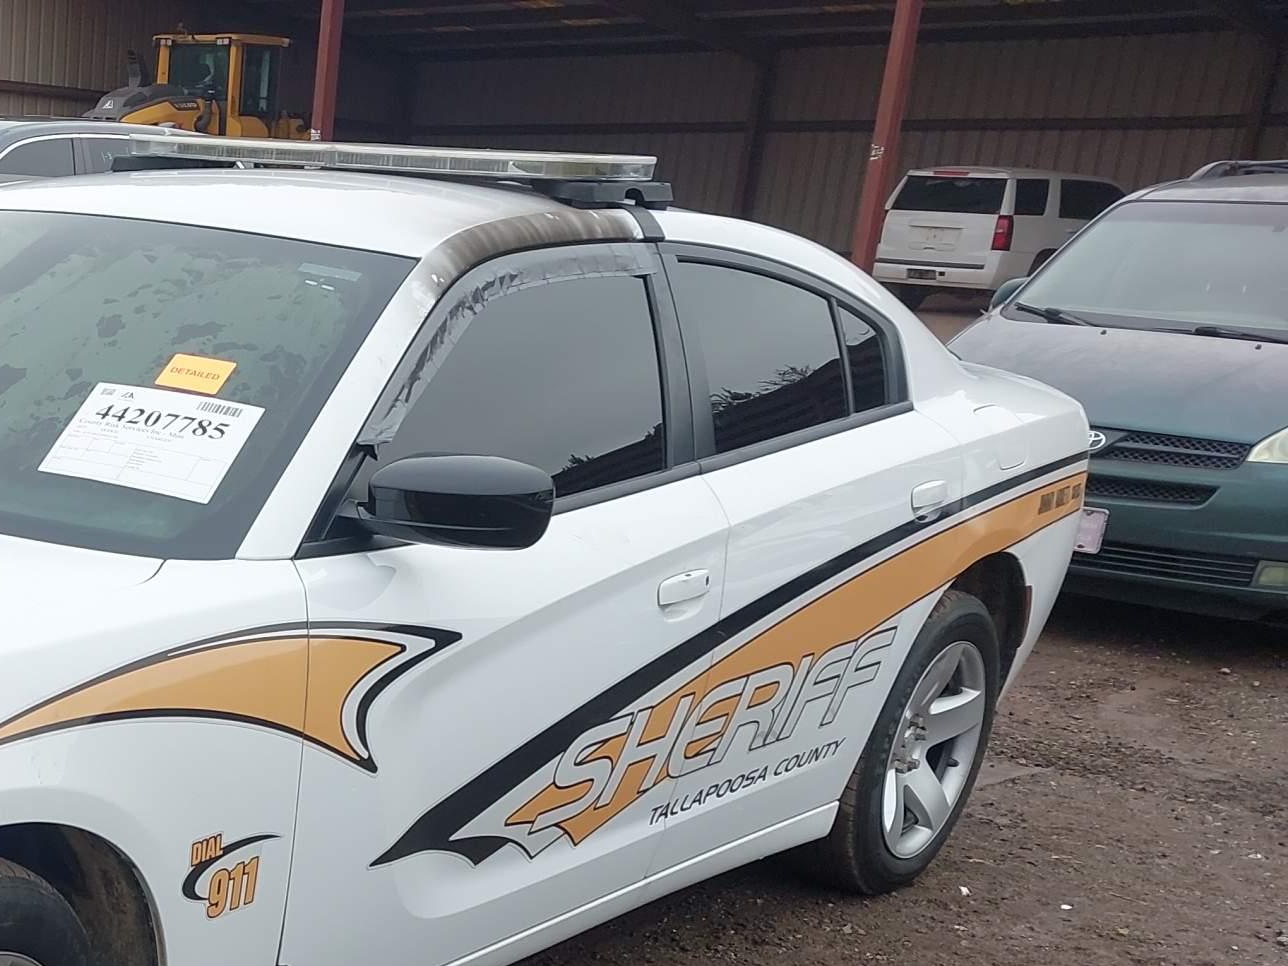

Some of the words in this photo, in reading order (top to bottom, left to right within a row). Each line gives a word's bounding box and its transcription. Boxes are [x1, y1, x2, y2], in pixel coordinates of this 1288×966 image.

[170, 367, 220, 381] DETAILED
[95, 404, 231, 440] 44207785
[529, 626, 897, 835] SHERIFF
[648, 764, 769, 827] TALLAPOOSA
[772, 736, 848, 778] COUNTY
[191, 832, 224, 867] DIAL
[206, 855, 260, 919] 911
